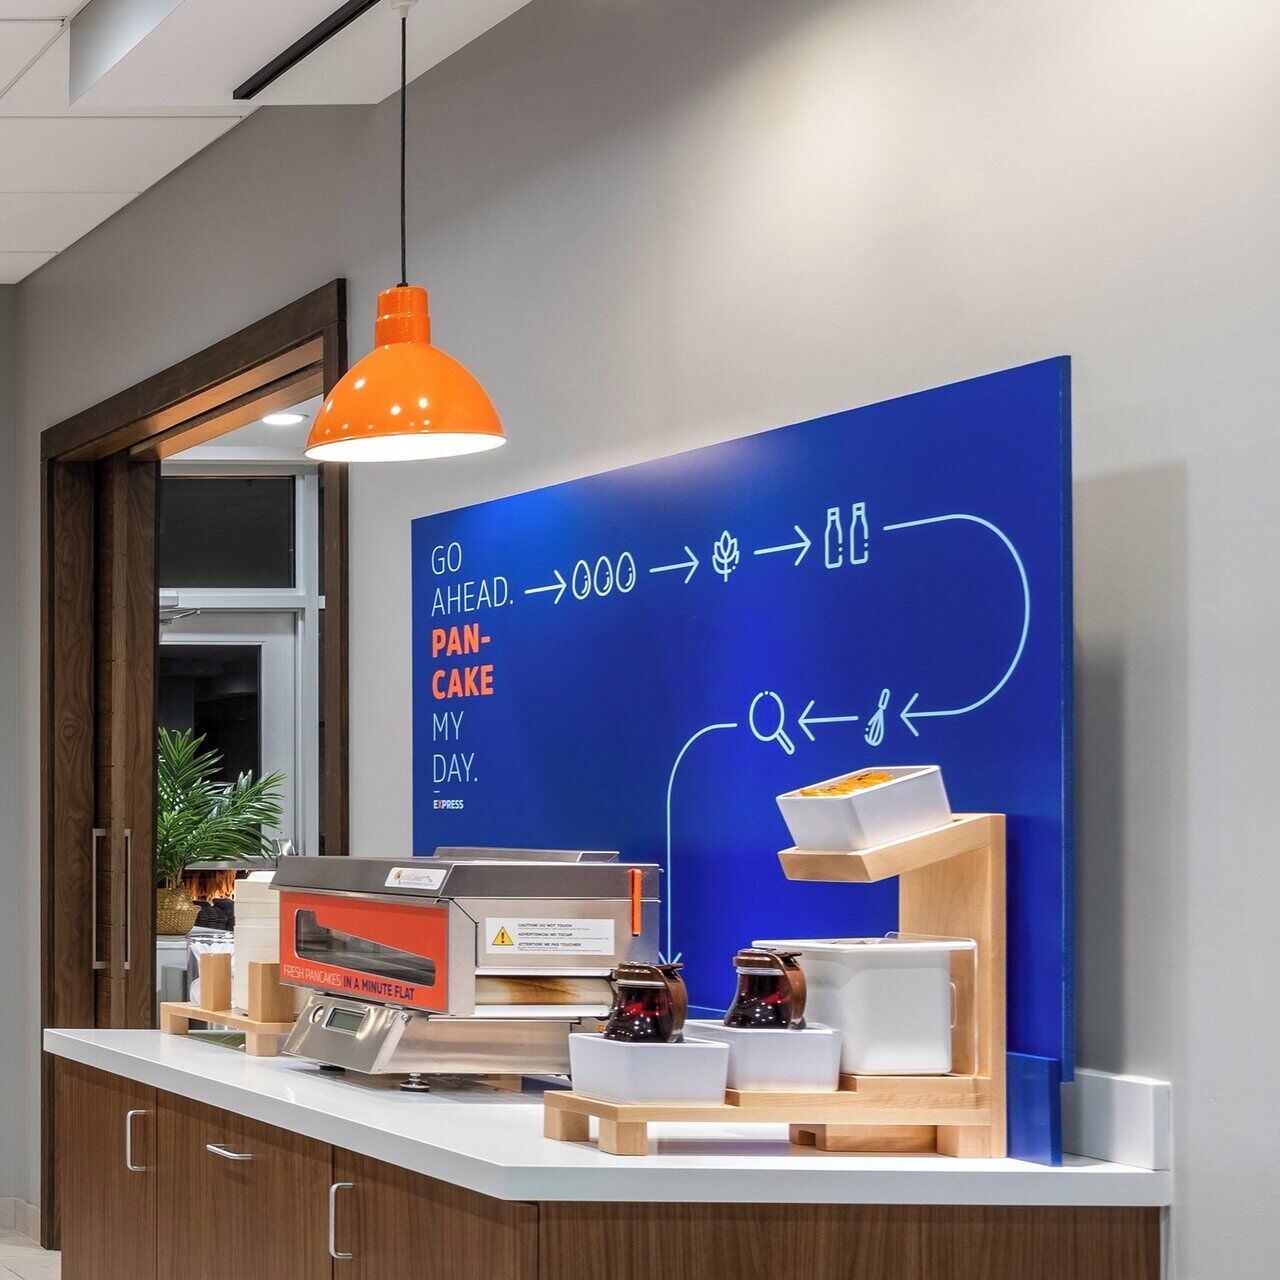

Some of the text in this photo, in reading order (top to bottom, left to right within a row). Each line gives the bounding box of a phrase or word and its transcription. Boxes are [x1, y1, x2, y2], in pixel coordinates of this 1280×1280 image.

[431, 542, 462, 575] GO
[431, 576, 514, 617] AHEAD.
[432, 623, 491, 658] PAN-
[431, 664, 494, 700] CAKE
[433, 710, 464, 742] MY
[433, 752, 478, 783] DAY.
[433, 800, 464, 809] EXPRESS
[283, 965, 415, 1001] FRESH PANCAKES IN A MINUTE FLAT
